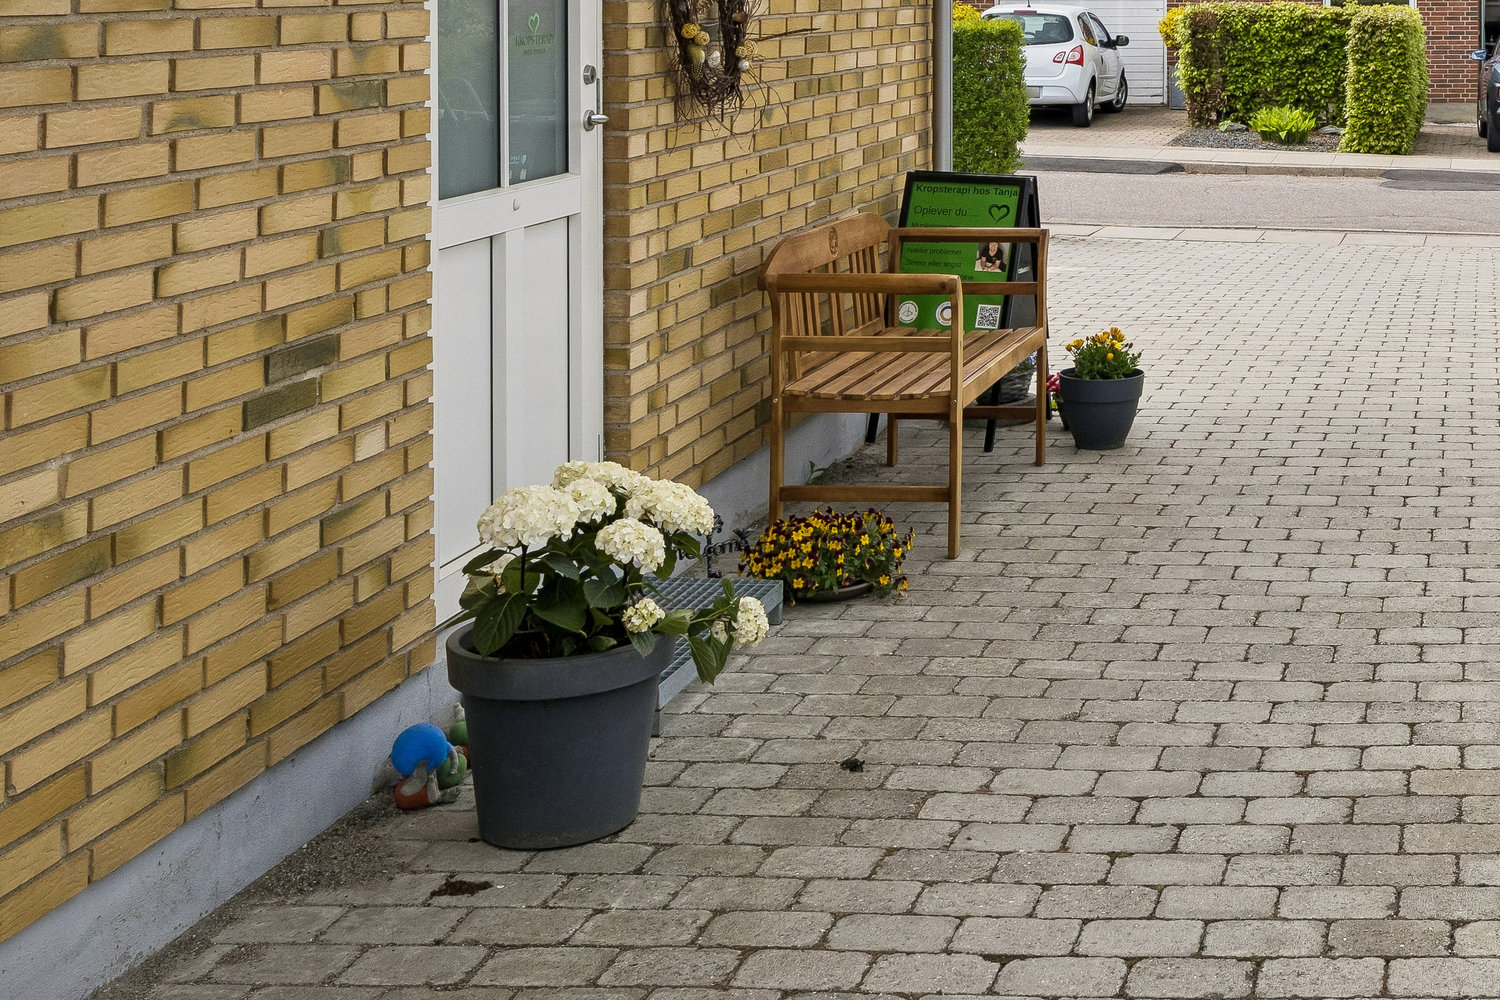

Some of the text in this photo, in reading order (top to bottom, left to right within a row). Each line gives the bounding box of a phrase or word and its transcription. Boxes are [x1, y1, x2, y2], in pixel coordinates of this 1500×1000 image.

[916, 184, 1018, 198] Kropsterapi hos Tanja
[914, 205, 952, 216] Oplever
[955, 207, 968, 217] du
[930, 247, 963, 255] problemer
